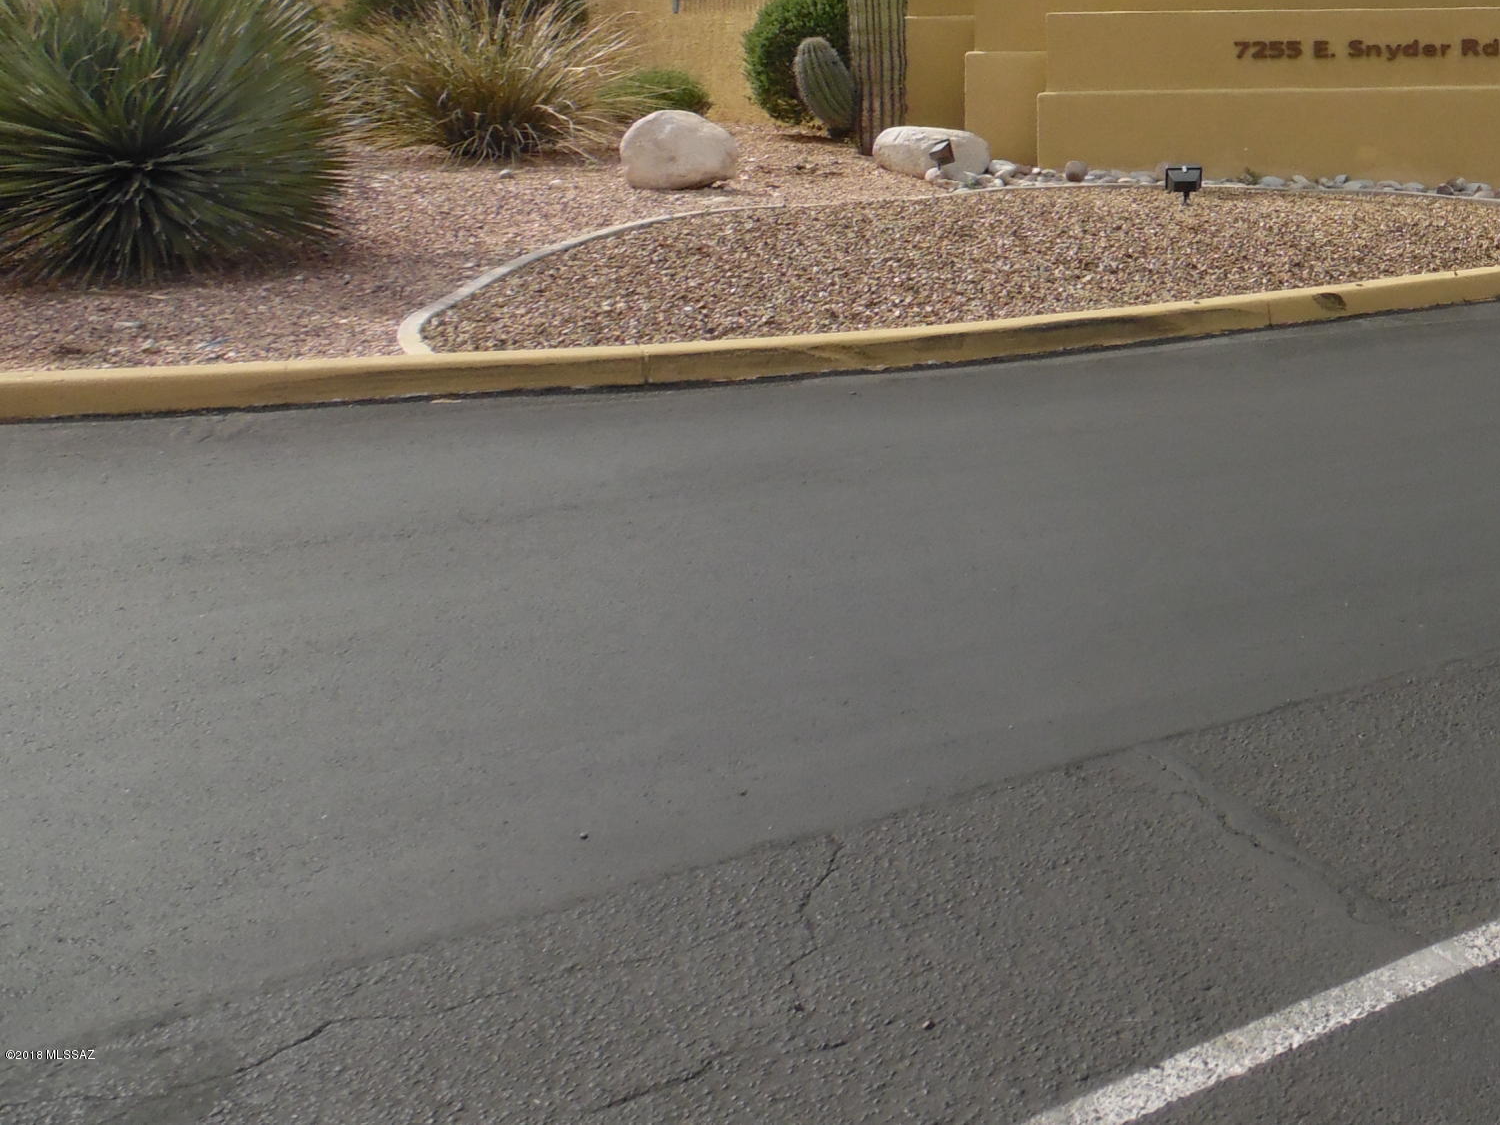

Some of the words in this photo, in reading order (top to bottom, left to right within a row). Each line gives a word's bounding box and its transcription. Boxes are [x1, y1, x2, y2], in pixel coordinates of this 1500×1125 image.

[1233, 40, 1303, 59] 7255
[1313, 40, 1336, 59] E.
[1348, 39, 1452, 62] Snyder
